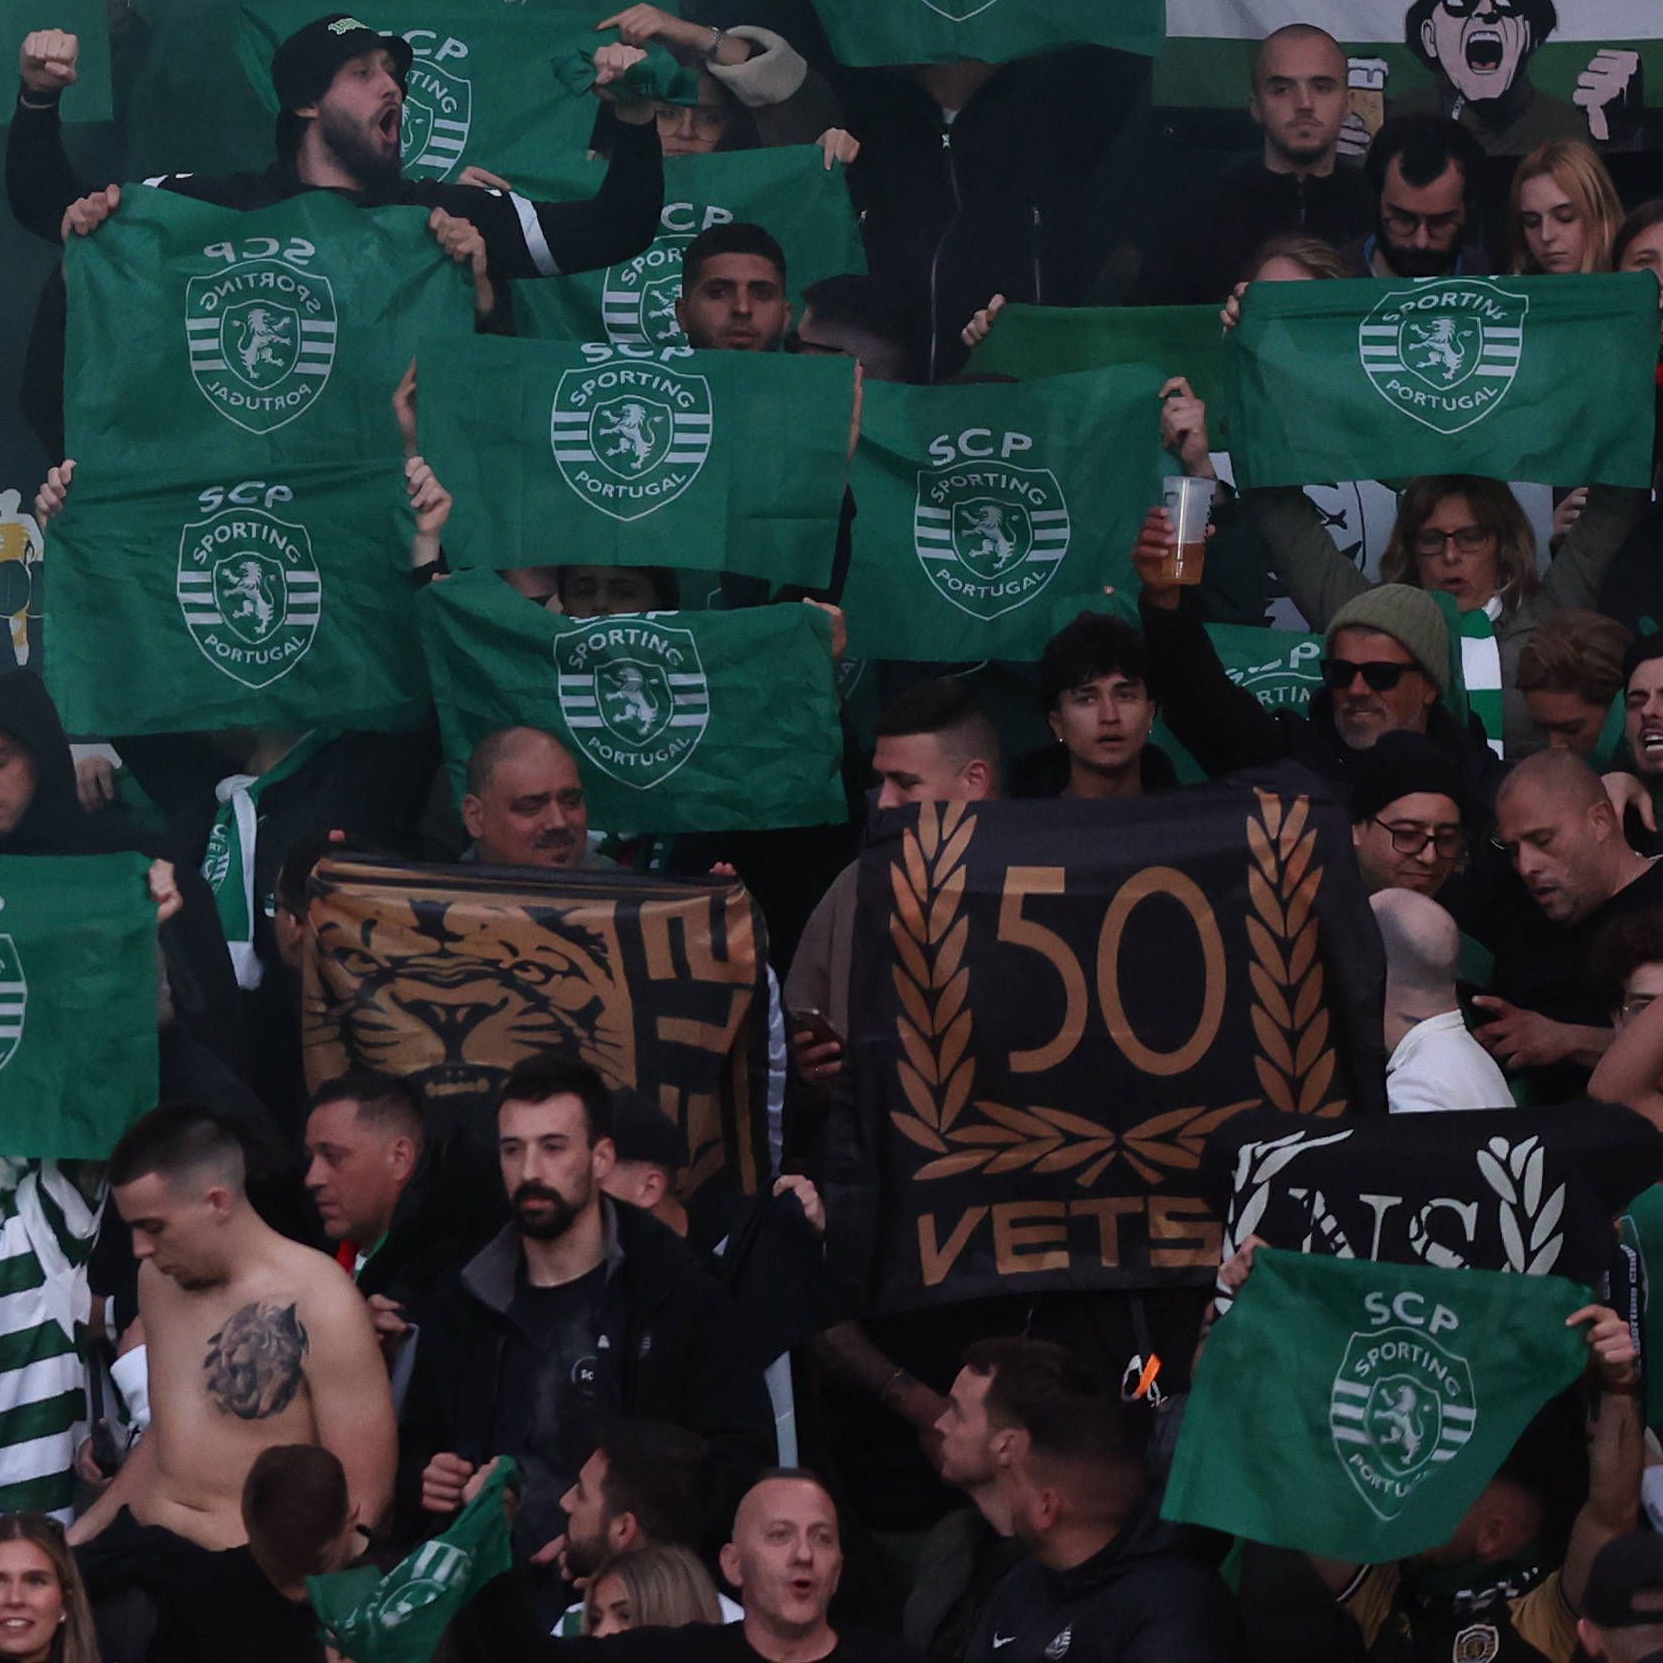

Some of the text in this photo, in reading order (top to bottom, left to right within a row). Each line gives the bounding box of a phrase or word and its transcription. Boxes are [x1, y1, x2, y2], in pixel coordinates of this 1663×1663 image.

[661, 202, 734, 232] CP
[579, 343, 696, 365] SCP
[570, 369, 696, 409] SPORTING
[1385, 379, 1499, 412] PORTUGAL
[928, 428, 1033, 467] SCP
[198, 481, 294, 513] SCP
[575, 469, 687, 500] PORTUGAL
[929, 472, 1047, 507] SPORTING
[193, 521, 302, 566] SPORTING
[936, 567, 1047, 600] PORTUGAL
[203, 633, 307, 666] PORTUGAL
[569, 627, 684, 671] SPORTING
[586, 736, 691, 767] PORTUGAL
[996, 865, 1227, 1077] 50
[1364, 1290, 1460, 1335] SCP
[1354, 1341, 1462, 1399] SPORTING
